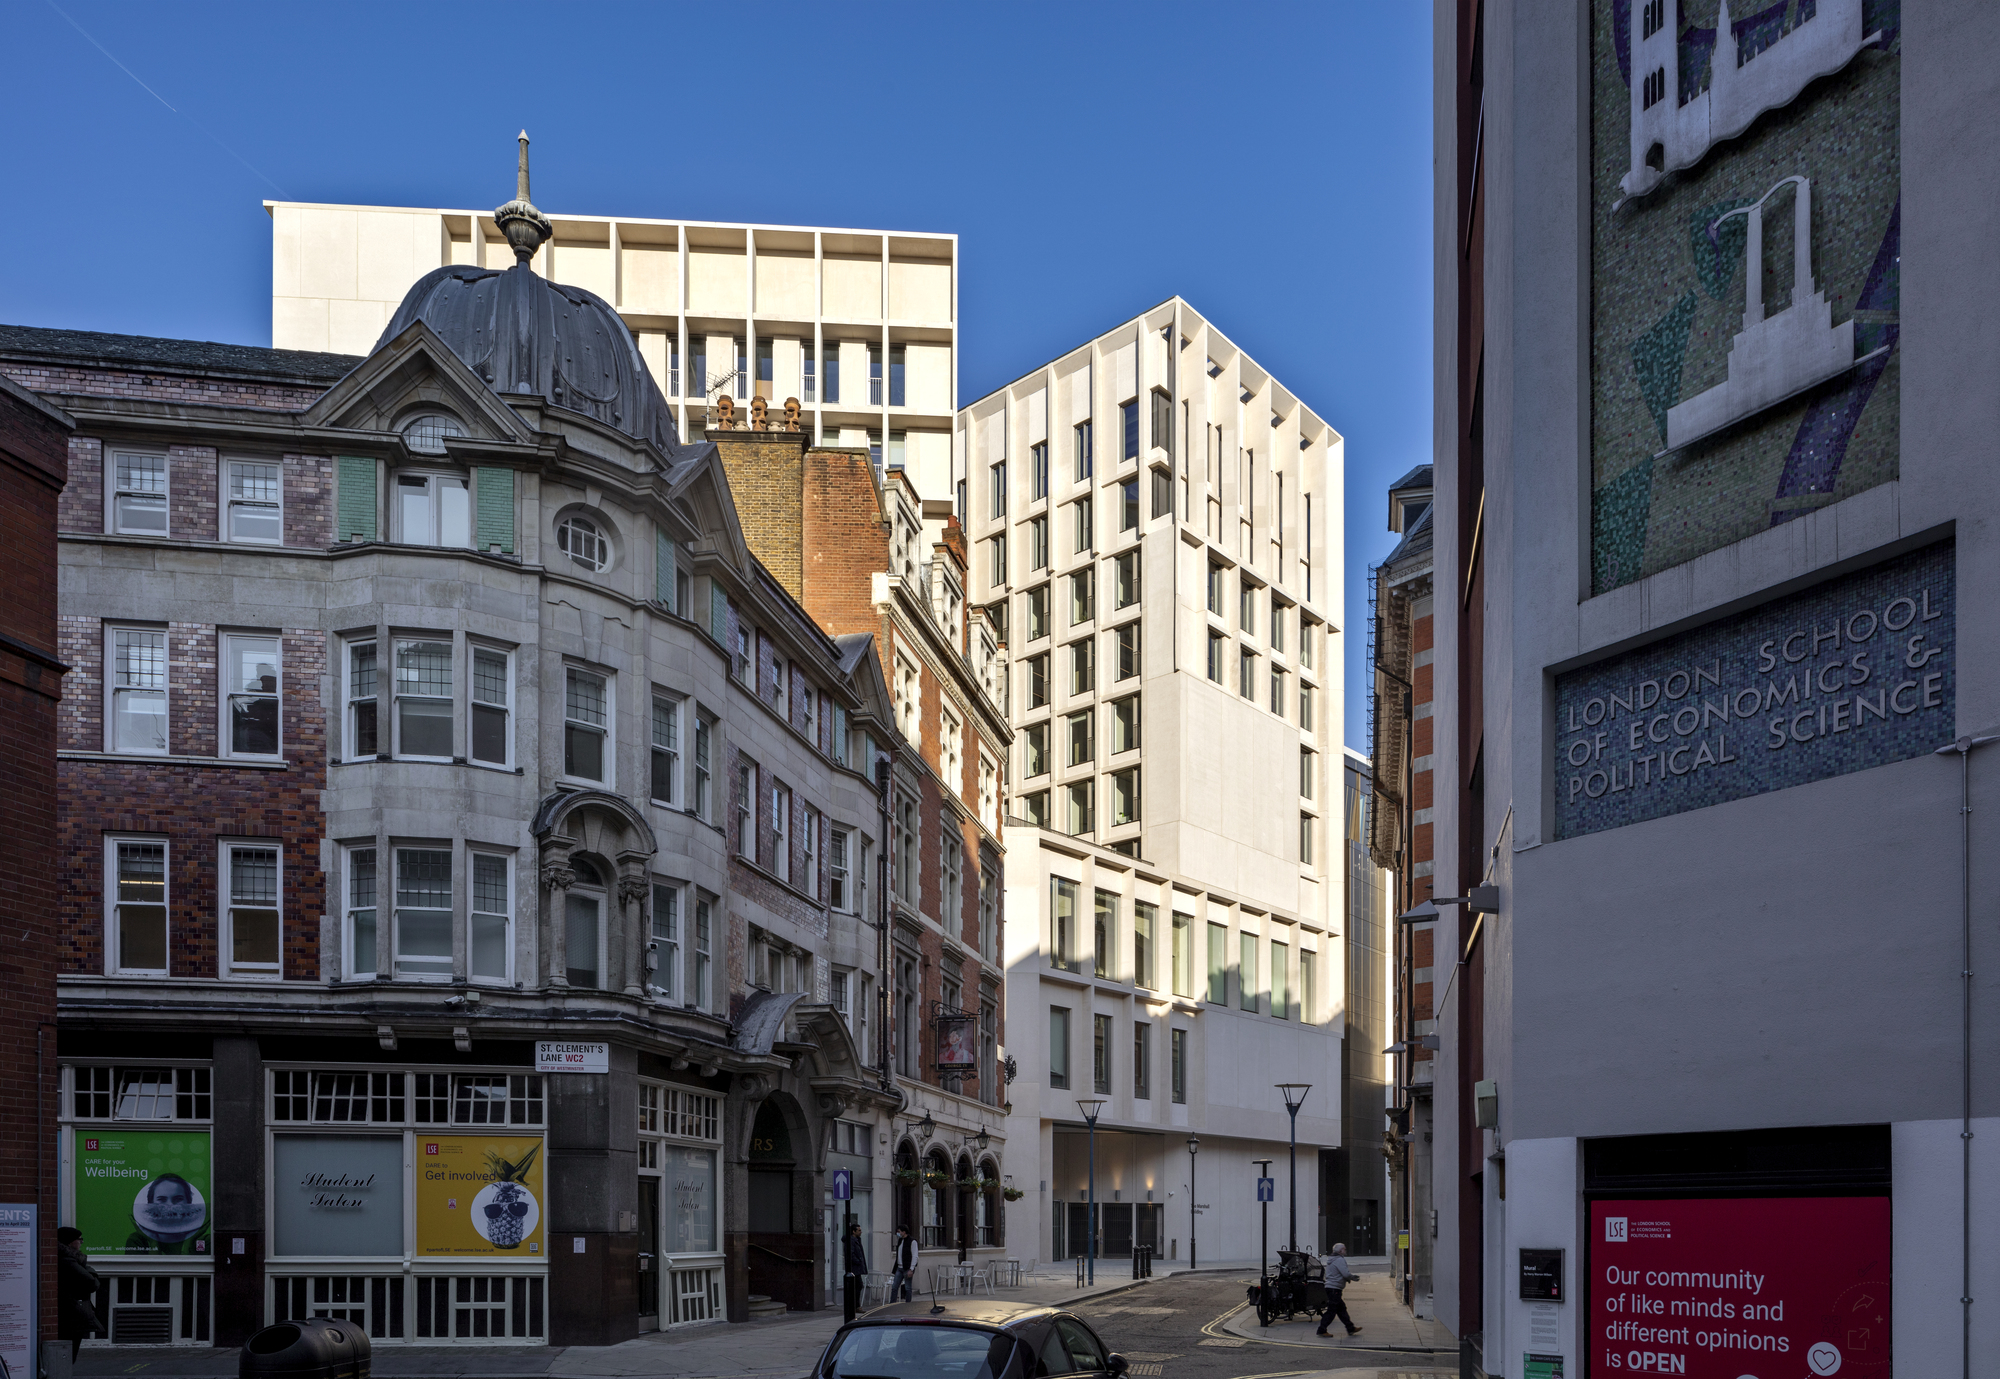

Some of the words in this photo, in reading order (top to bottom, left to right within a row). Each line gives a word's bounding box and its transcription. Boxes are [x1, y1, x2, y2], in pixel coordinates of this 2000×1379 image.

[1569, 658, 1721, 733] LONDON
[1758, 588, 1942, 673] SCHOOL
[1568, 731, 1607, 766] OF
[1630, 652, 1870, 750] ECONOMICS
[1906, 634, 1942, 668] &
[1569, 734, 1735, 803] POLITICAL
[1768, 672, 1942, 749] SCIENCE
[540, 1044, 552, 1052] ST.
[556, 1044, 603, 1054] CLEMENT'S
[541, 1054, 562, 1062] LANE
[565, 1054, 584, 1062] WC2
[87, 1140, 97, 1150] LSE
[427, 1145, 437, 1154] LSE
[750, 1138, 773, 1151] RS
[85, 1166, 148, 1180] Wellbeing
[301, 1172, 376, 1187] Student
[425, 1170, 445, 1181] Get
[448, 1170, 496, 1181] involved
[675, 1179, 704, 1193] Student
[310, 1192, 366, 1207] Salon
[1609, 1221, 1624, 1238] LSE
[1606, 1265, 1641, 1286] Our
[1645, 1269, 1765, 1295] community
[1606, 1293, 1626, 1312] of
[1632, 1293, 1665, 1315] like
[1671, 1297, 1735, 1319] minds
[1742, 1300, 1783, 1321] and
[1606, 1320, 1689, 1345] different
[1695, 1328, 1790, 1353] opinions
[1606, 1348, 1621, 1368] is
[1627, 1350, 1686, 1374] OPEN
